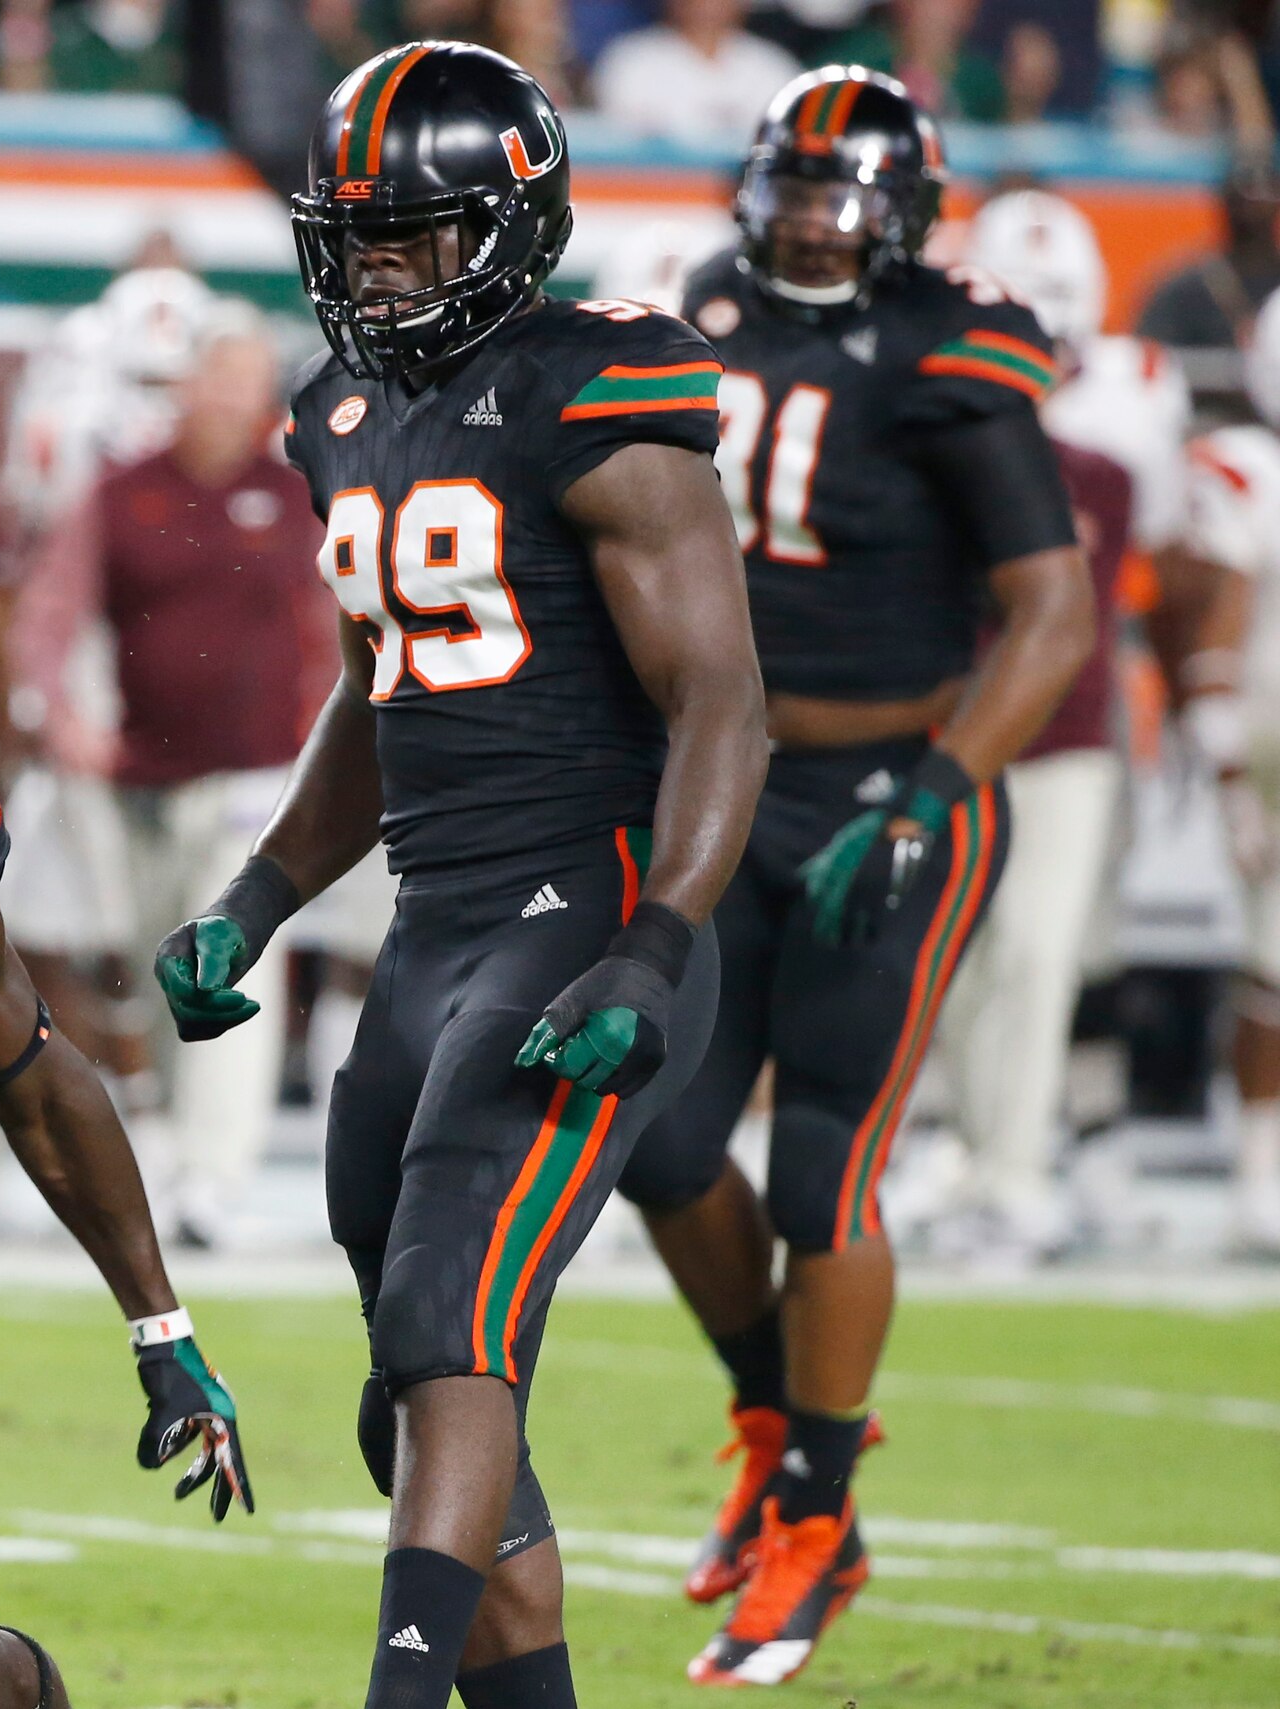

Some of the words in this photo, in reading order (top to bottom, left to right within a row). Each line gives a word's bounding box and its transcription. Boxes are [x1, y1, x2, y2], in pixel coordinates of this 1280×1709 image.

[499, 106, 563, 181] U
[336, 180, 374, 194] ACC
[463, 411, 503, 427] adidas
[317, 477, 532, 702] 99
[521, 899, 569, 919] adidas
[388, 1637, 430, 1653] adidas
